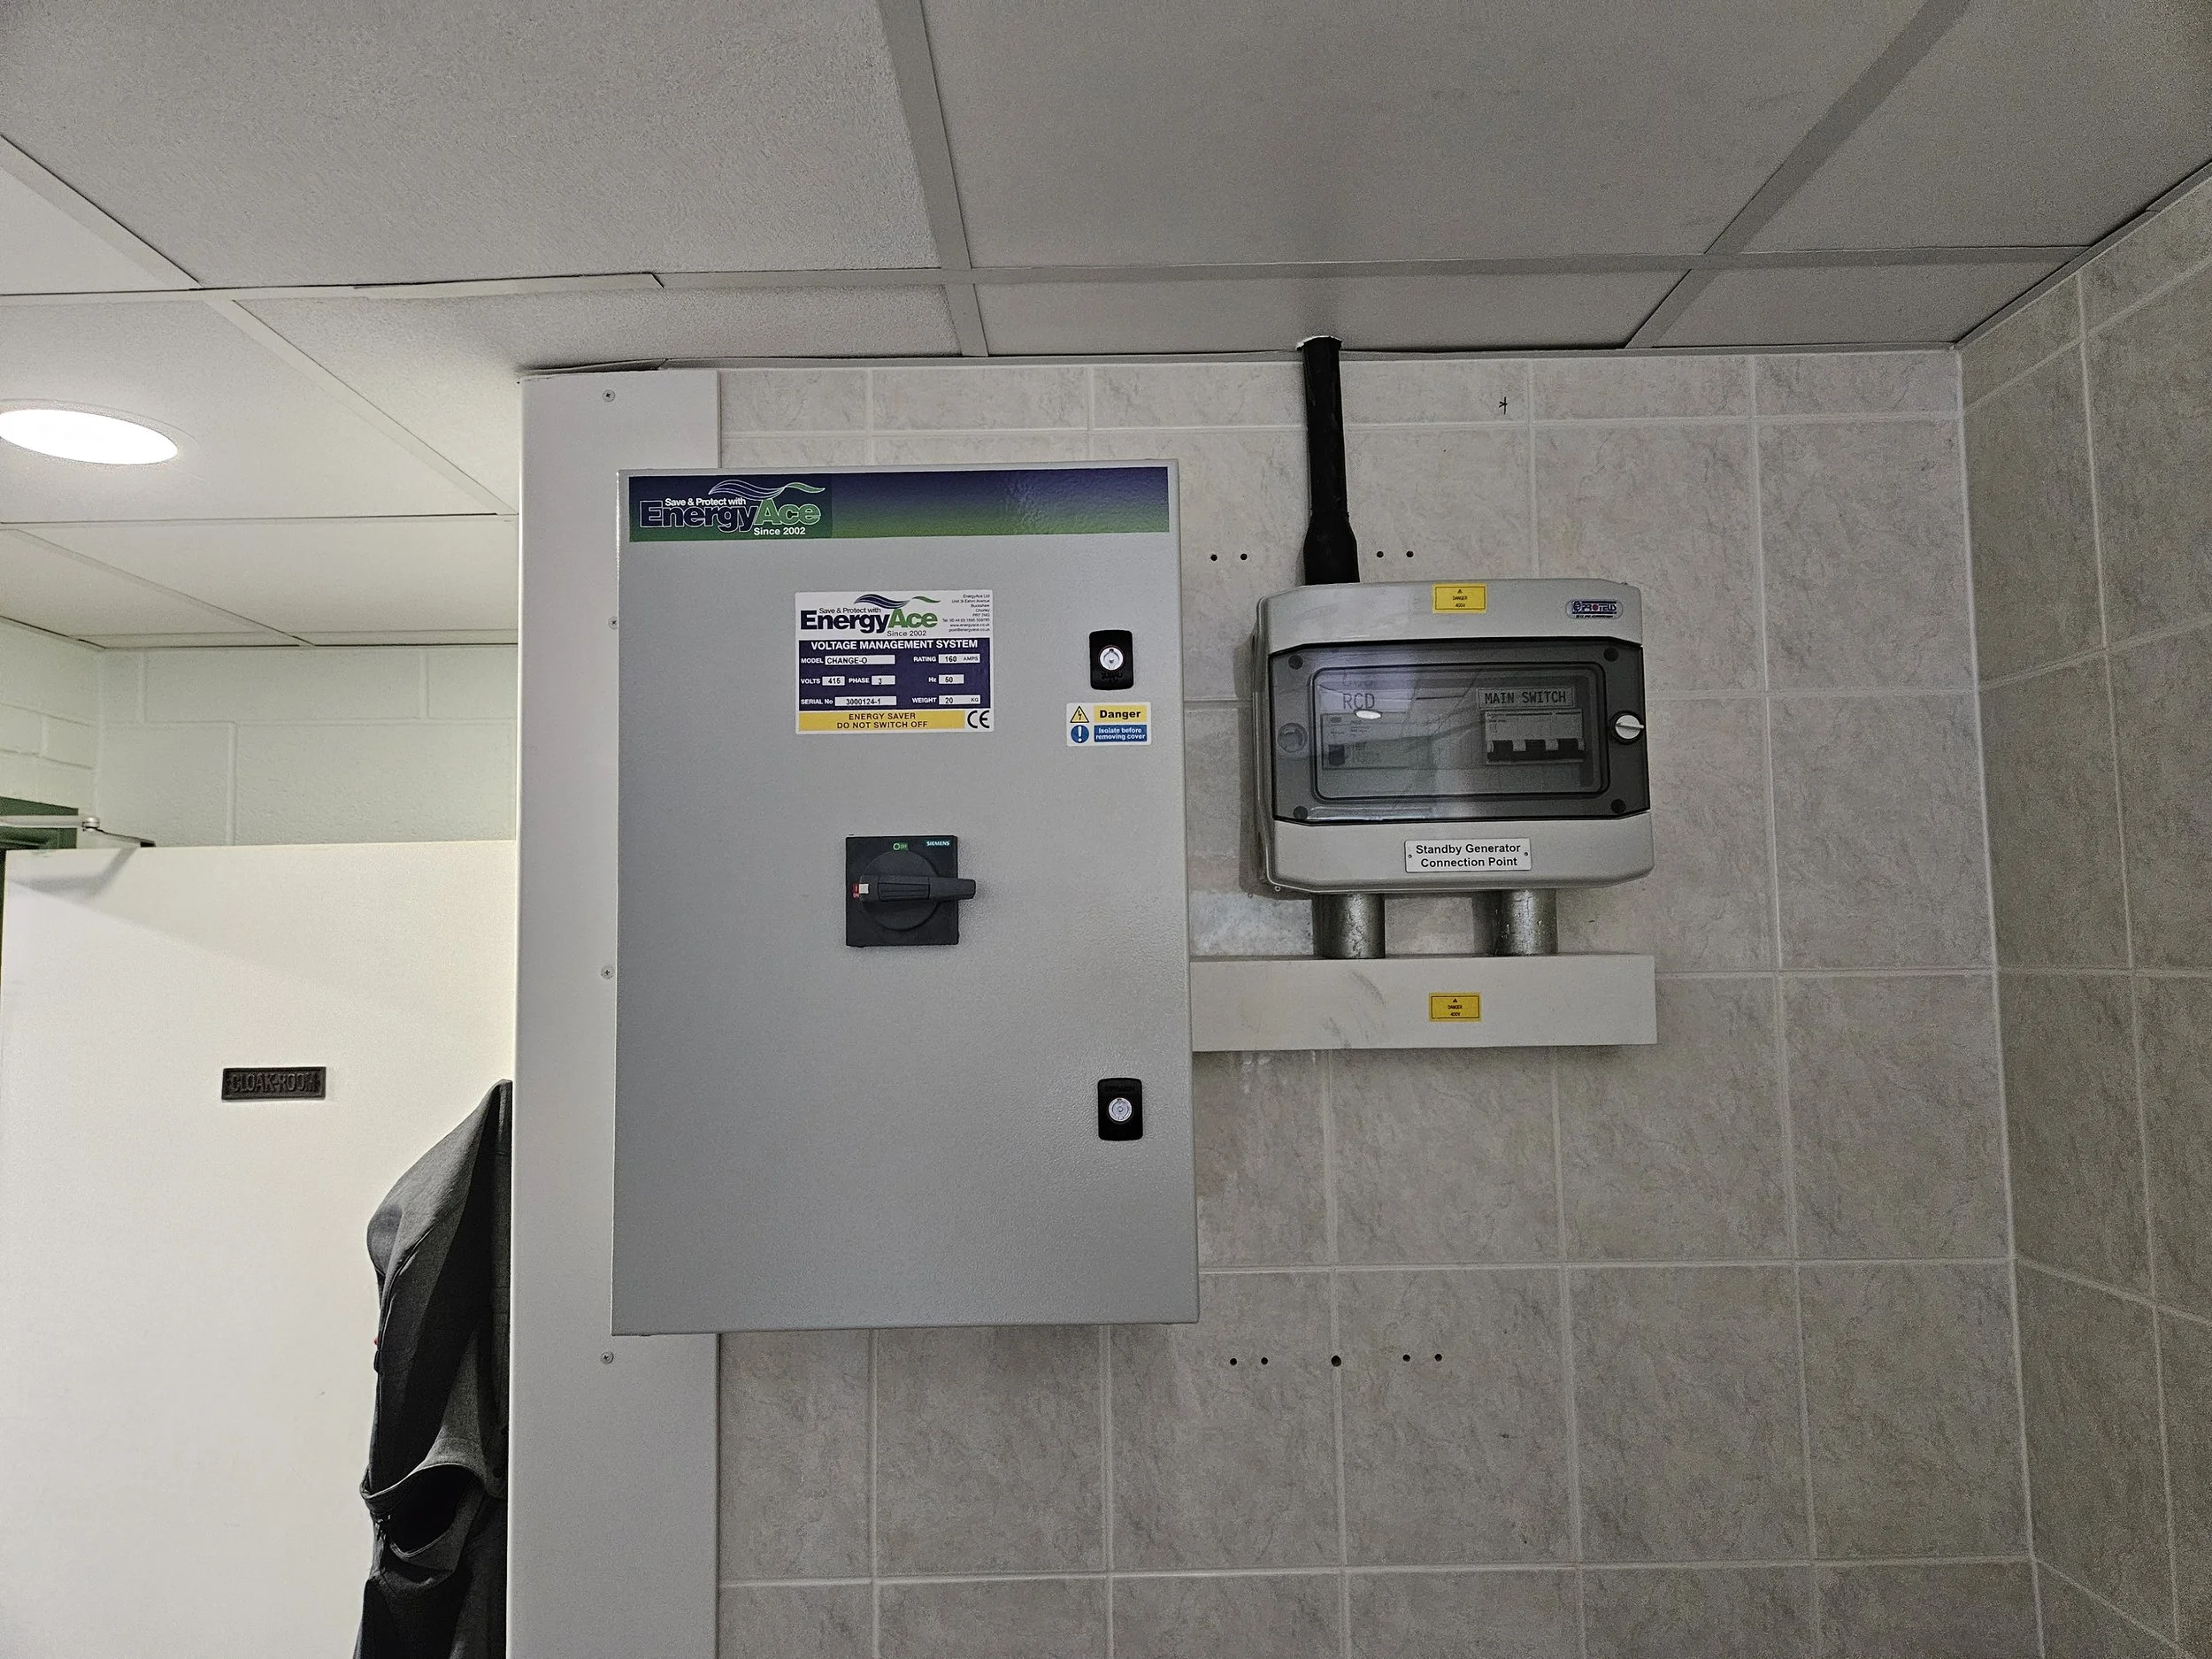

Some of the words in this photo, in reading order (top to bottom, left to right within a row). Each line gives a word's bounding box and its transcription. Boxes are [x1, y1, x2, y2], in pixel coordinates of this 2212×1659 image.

[696, 497, 727, 506] Protect
[729, 496, 746, 505] with
[640, 498, 821, 533] EnergyAce
[801, 609, 938, 634] EnergyAce
[810, 641, 857, 650] VOLTAGE
[859, 640, 933, 649] MANAGEMENT
[936, 639, 978, 649] SYSTEM
[1342, 693, 1375, 709] RCD
[1485, 692, 1515, 704] MAIN
[1522, 691, 1566, 703] SWITCH
[1099, 710, 1141, 719] Danger
[1416, 844, 1462, 856] Standby
[1465, 843, 1521, 853] Generator
[1420, 857, 1485, 868] Connection
[1488, 856, 1518, 866] Point
